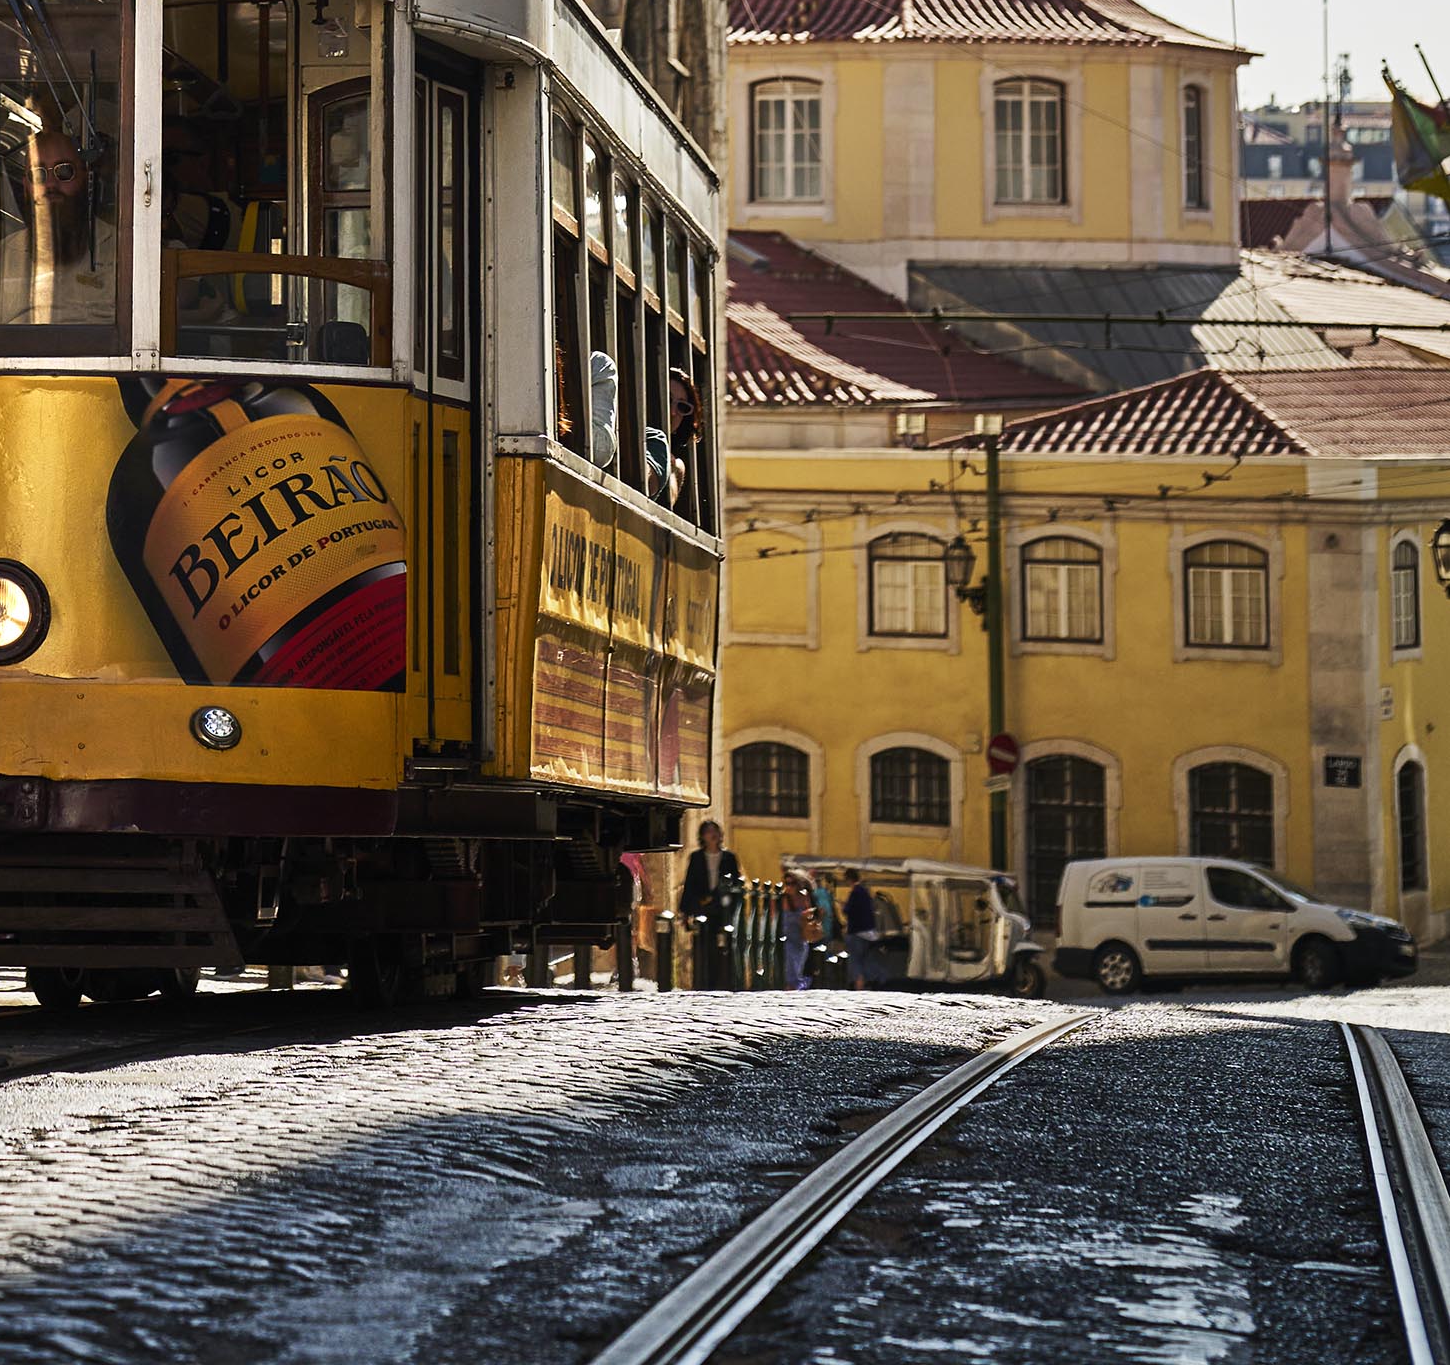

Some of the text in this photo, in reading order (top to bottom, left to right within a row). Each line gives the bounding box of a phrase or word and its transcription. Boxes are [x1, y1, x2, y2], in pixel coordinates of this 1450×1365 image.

[192, 451, 247, 497] CARRANCA
[227, 451, 305, 498] LICOR
[168, 454, 389, 620] BEIRÃO
[218, 519, 399, 631] O LICOR DE PORTUGAL
[557, 526, 587, 604] LICOR
